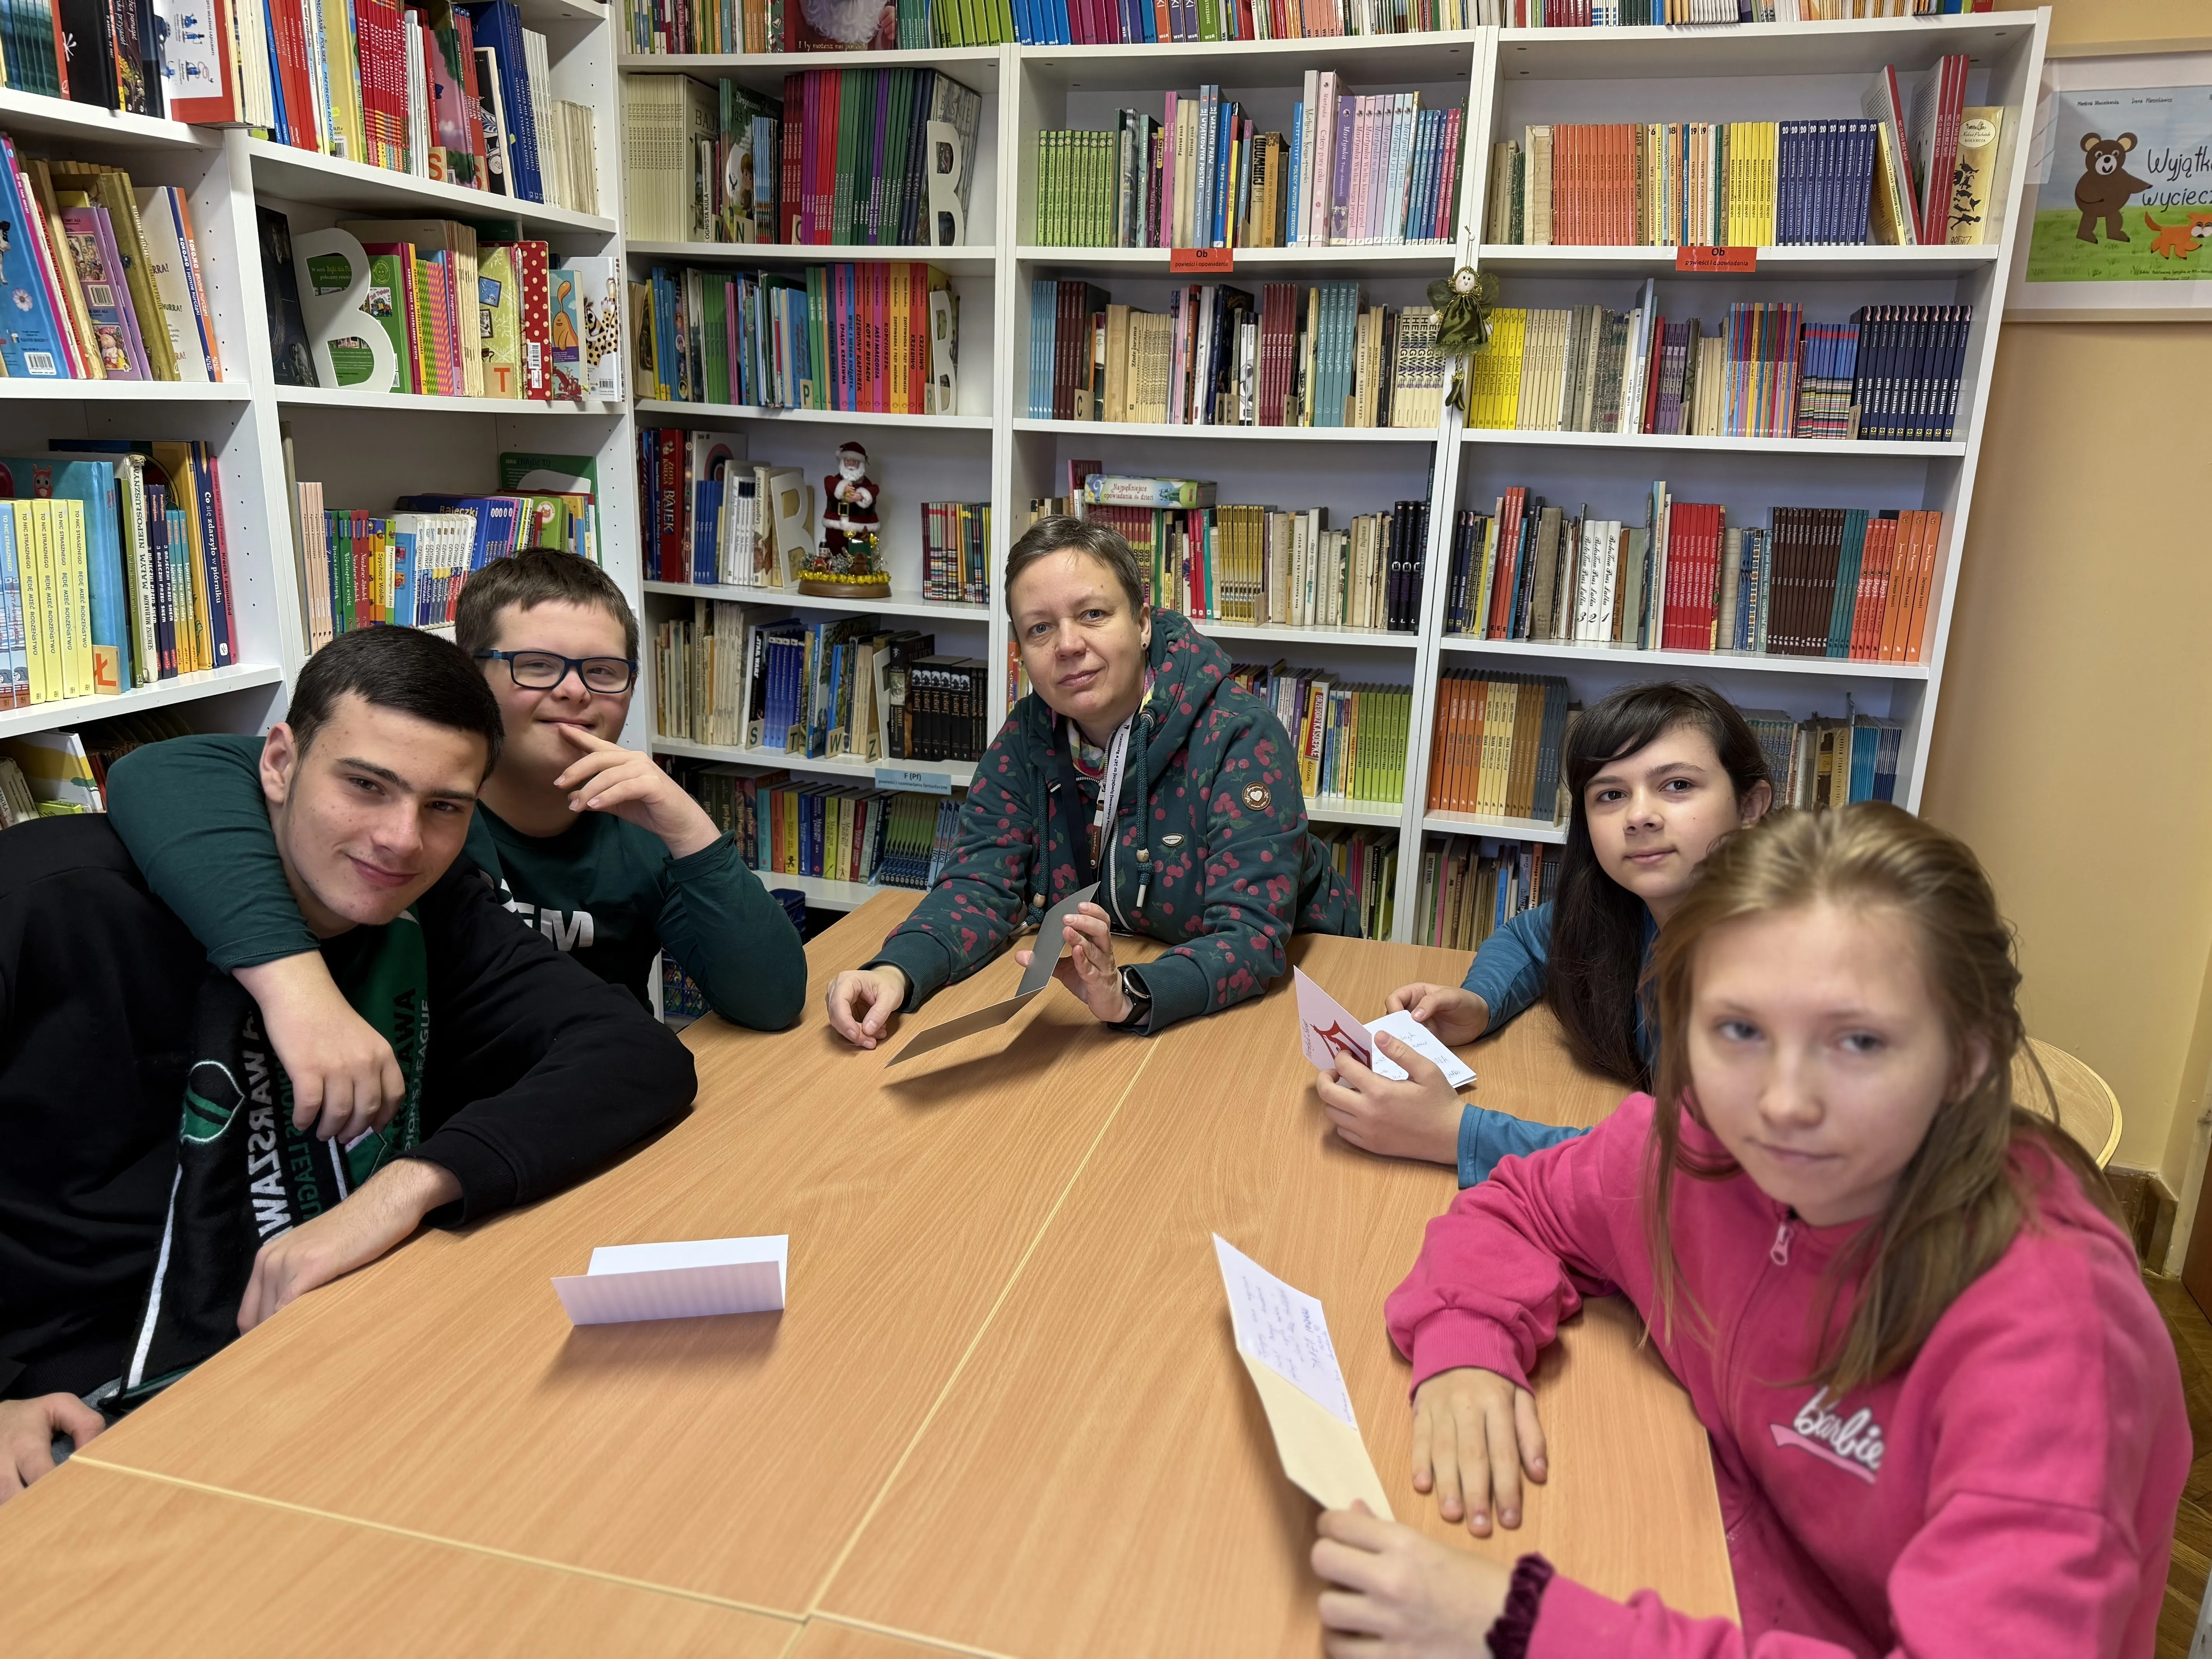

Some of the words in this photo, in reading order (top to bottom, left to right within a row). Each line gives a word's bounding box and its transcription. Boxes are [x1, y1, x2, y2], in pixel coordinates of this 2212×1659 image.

[127, 13, 138, 41] pomagać
[429, 153, 442, 181] S
[2147, 146, 2212, 181] Wyjątk
[927, 120, 964, 246] B
[737, 221, 744, 243] N
[1712, 248, 1725, 256] Ob
[153, 263, 169, 273] RRA!
[180, 237, 189, 267] KOKOJKO
[192, 291, 201, 315] kurczaki
[189, 239, 199, 268] KOKOJKO
[199, 292, 208, 316] kurczaki
[291, 228, 394, 393] B
[1398, 318, 1410, 379] HEMINGWAY
[1407, 318, 1419, 379] HEMINGWAY
[1416, 318, 1428, 379] HEMINGWAY
[495, 367, 510, 393] T
[1661, 367, 1669, 412] ARTYSTA
[803, 385, 810, 405] P
[1077, 395, 1082, 417] C
[204, 491, 210, 503] Co
[1113, 483, 1147, 493] Najpiękniejsze
[3, 515, 8, 524] TO
[133, 465, 146, 549] NIEPOSŁUSZNYM
[440, 505, 479, 517] Bajeczki
[663, 489, 675, 534] BAJEK
[207, 518, 216, 557] zdarzyło
[1582, 536, 1591, 567] Bolesław
[1607, 535, 1616, 565] Bolesław
[5, 534, 13, 572] STRASZNEGO
[1592, 536, 1601, 568] Bolesław
[141, 553, 149, 590] MAŁYM
[211, 566, 221, 604] piórniku
[1579, 585, 1587, 606] Lalka
[1589, 586, 1597, 607] Lalka
[1603, 586, 1611, 605] Lalka
[1577, 612, 1587, 622] 3
[1588, 613, 1597, 623] 2
[1601, 613, 1610, 622] 1
[94, 653, 117, 687] Ł
[1315, 695, 1323, 723] GRZEGORZ
[750, 727, 758, 745] S
[790, 732, 797, 750] T
[830, 733, 842, 753] W
[869, 738, 876, 759] Z
[1311, 723, 1320, 756] KASDEPKE
[910, 773, 921, 781] (Pf)
